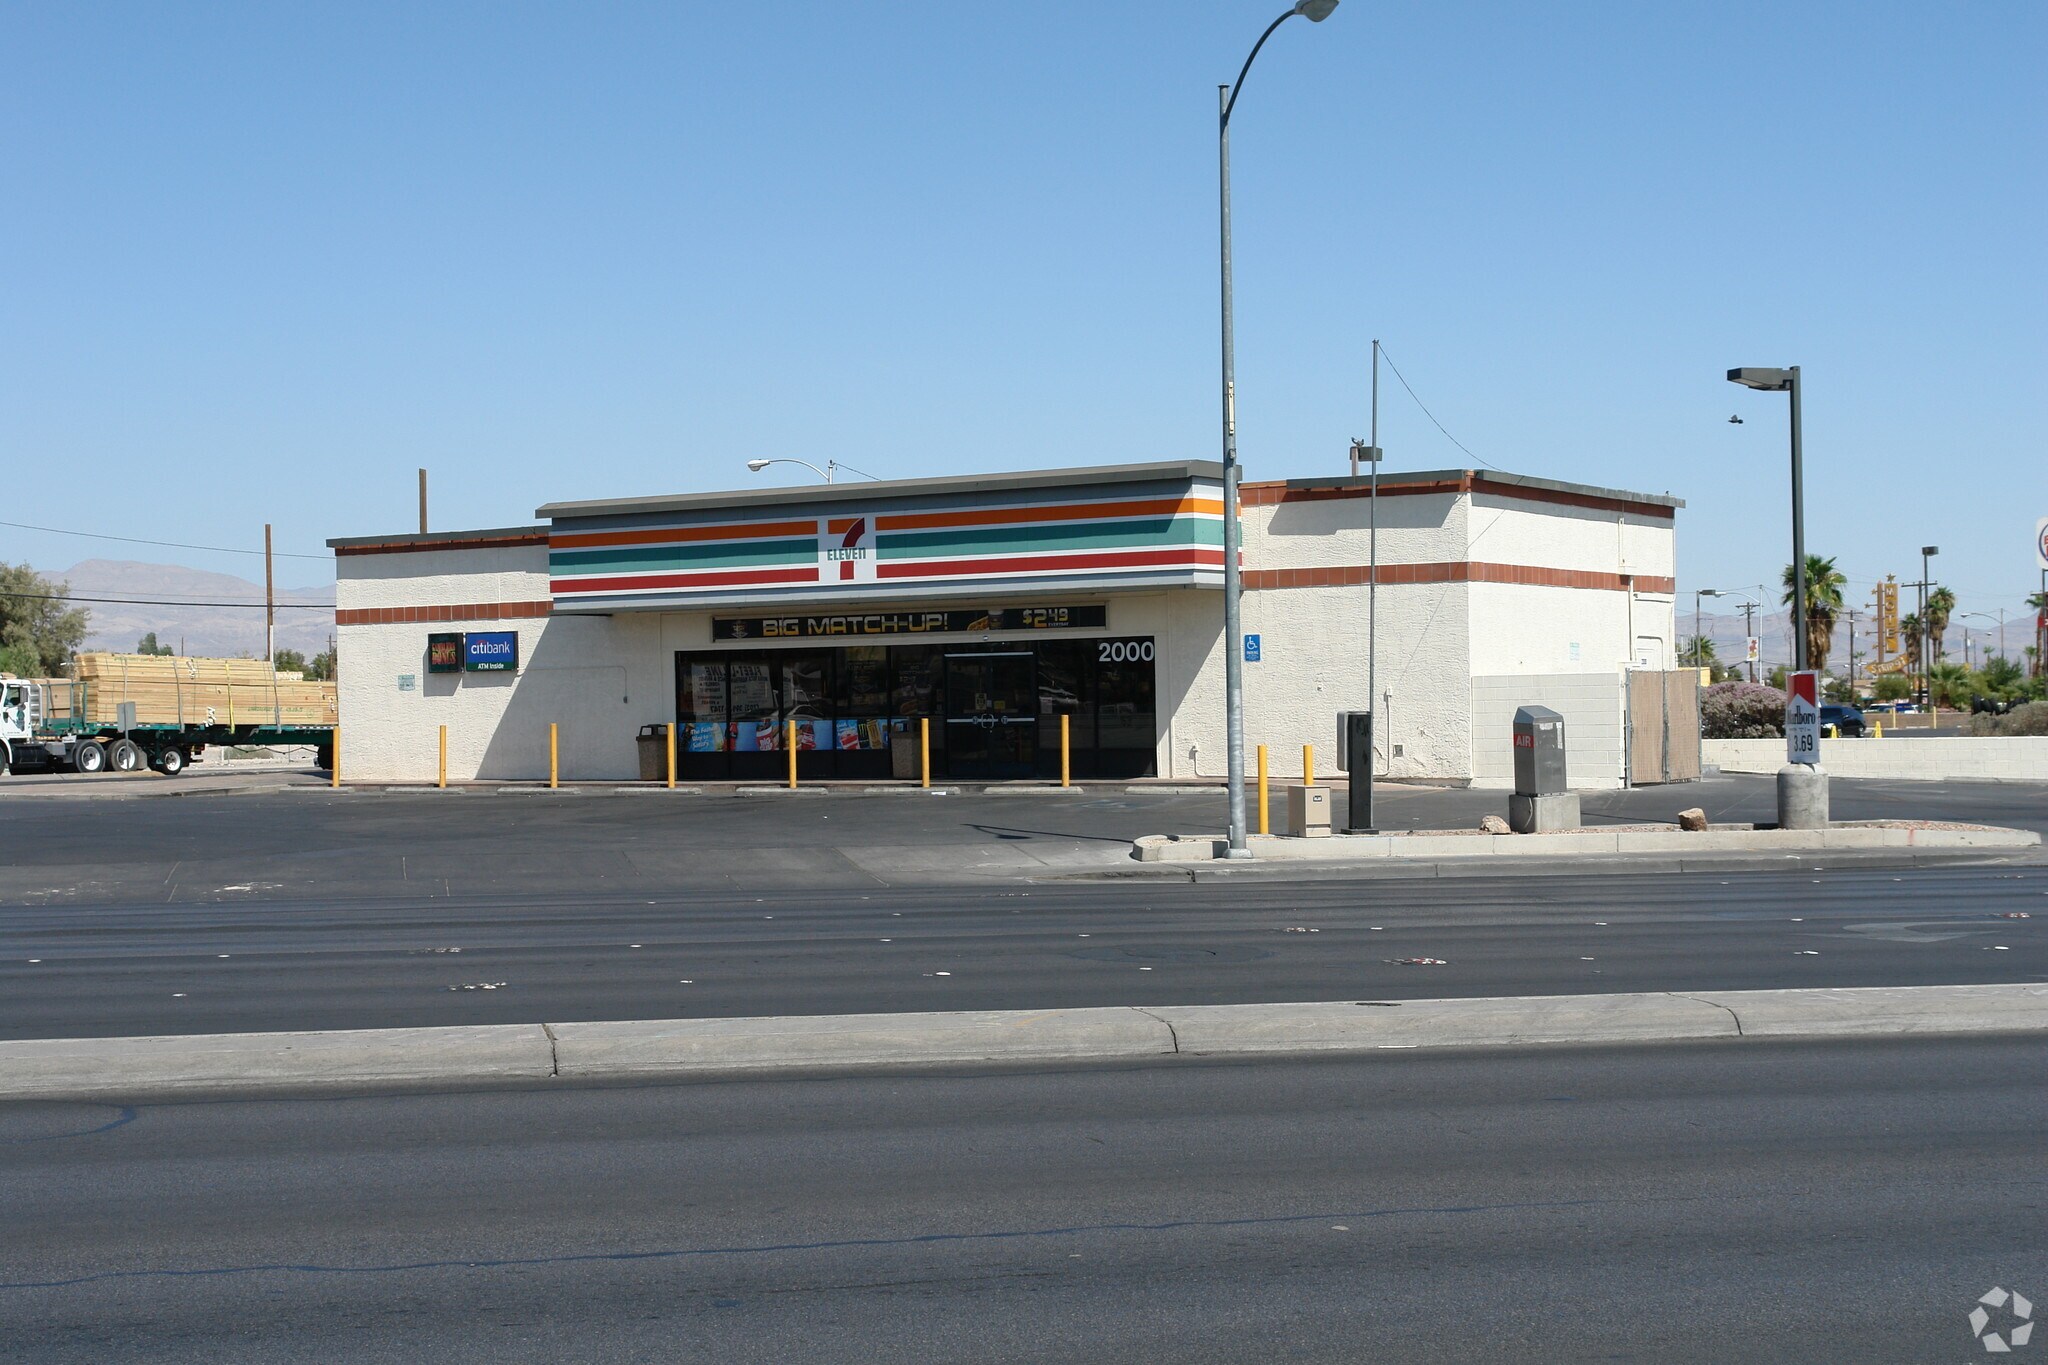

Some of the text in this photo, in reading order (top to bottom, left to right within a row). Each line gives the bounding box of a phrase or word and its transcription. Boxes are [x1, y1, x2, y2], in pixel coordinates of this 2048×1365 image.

[827, 516, 867, 580] 7
[762, 618, 800, 637] BIG
[807, 612, 949, 635] MATCH-UP!
[1885, 587, 1896, 652] MOTEL
[470, 640, 511, 654] citibank
[1098, 641, 1155, 662] 2000
[1516, 735, 1531, 747] AIR
[1794, 734, 1814, 752] 3.69
